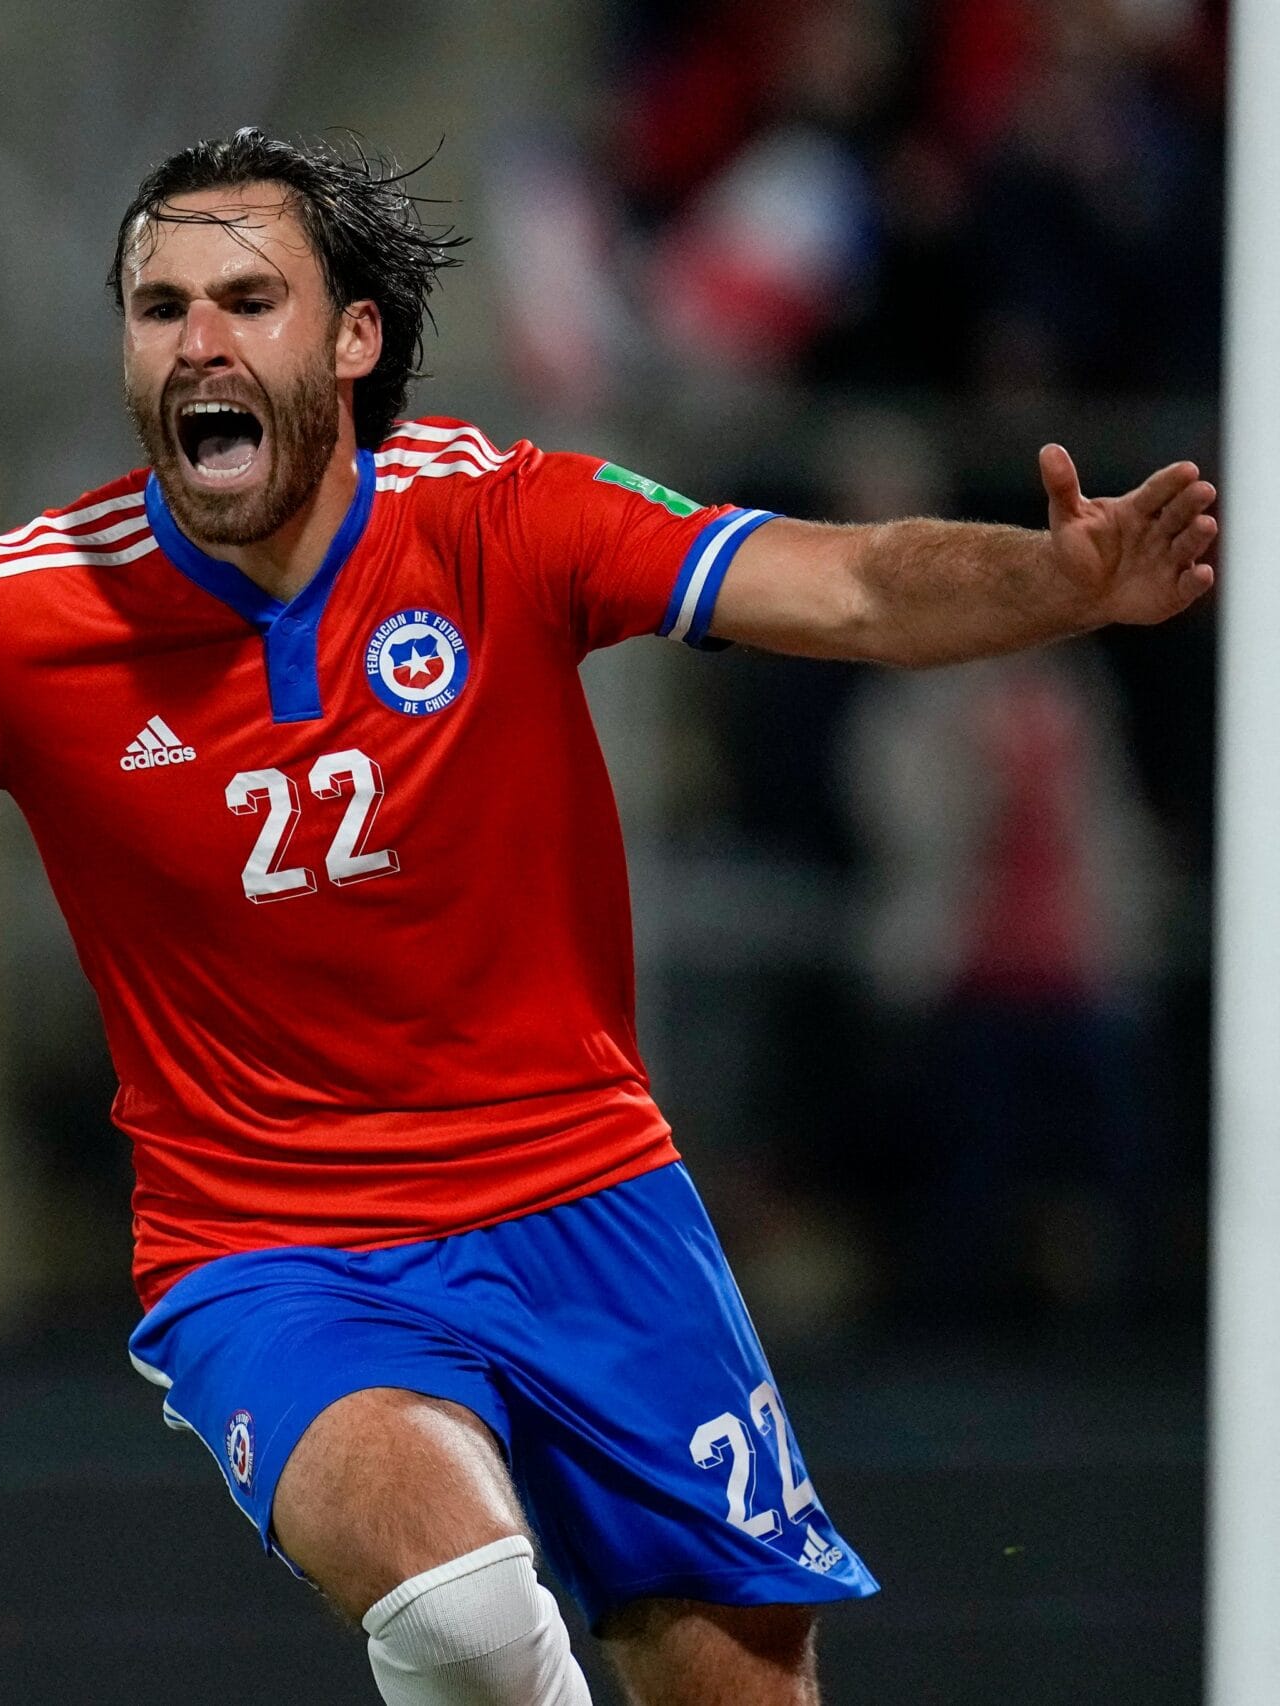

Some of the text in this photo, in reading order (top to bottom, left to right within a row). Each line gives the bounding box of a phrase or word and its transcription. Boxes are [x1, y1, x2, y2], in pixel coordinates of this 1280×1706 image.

[367, 611, 464, 675] FEDERACION DE FUTBOL
[403, 689, 455, 714] DE CHILE
[120, 746, 197, 771] adidas
[224, 748, 401, 905] 22
[689, 1379, 818, 1545] 22
